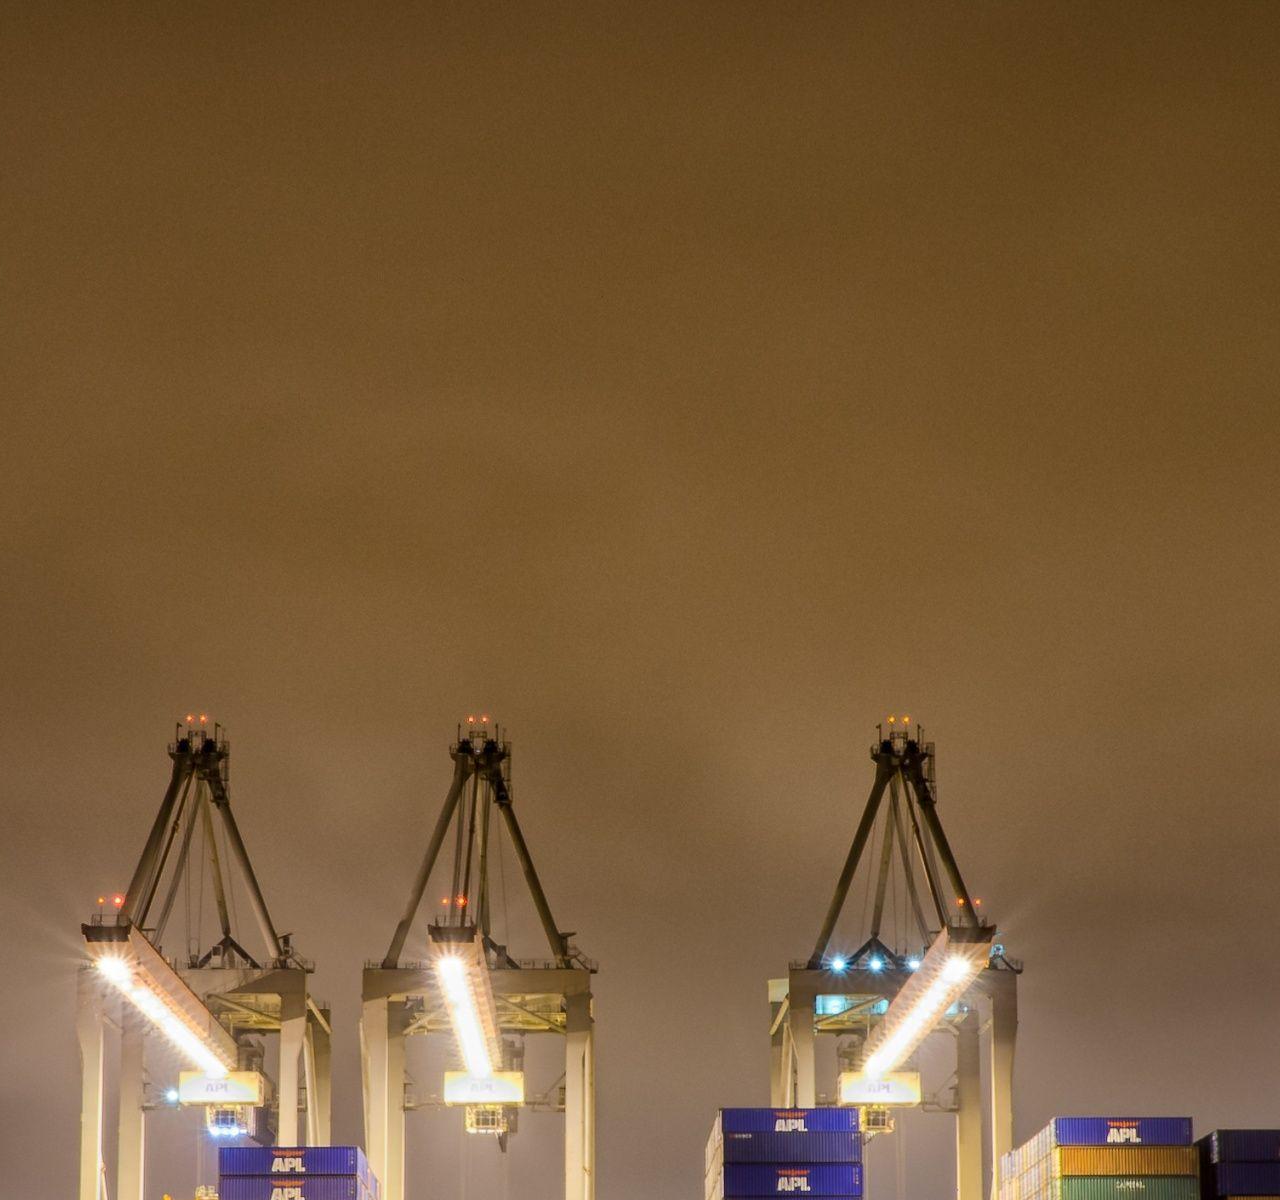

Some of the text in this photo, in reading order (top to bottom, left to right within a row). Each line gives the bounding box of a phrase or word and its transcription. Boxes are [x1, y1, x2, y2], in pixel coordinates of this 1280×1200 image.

[775, 1119, 808, 1132] APL
[1107, 1128, 1141, 1143] APL
[272, 1158, 306, 1172] APL
[777, 1177, 810, 1191] APL
